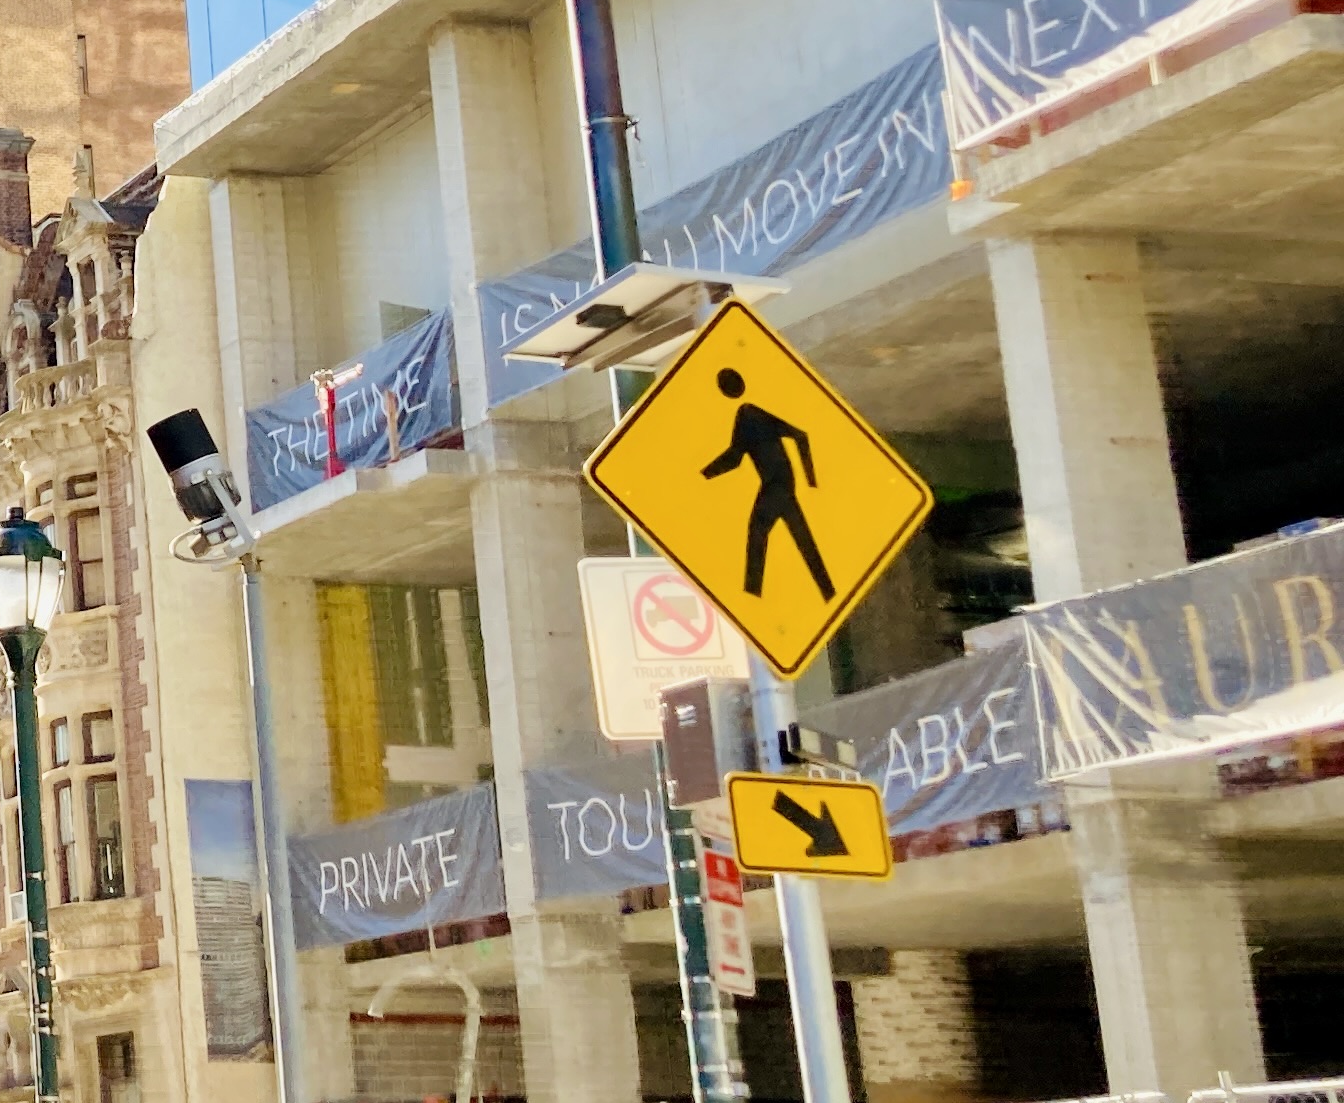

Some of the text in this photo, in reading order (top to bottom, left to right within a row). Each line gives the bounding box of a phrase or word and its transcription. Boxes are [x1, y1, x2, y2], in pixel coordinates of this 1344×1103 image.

[712, 133, 862, 273] MOVE
[878, 92, 935, 178] IN
[268, 355, 428, 476] THE TIME
[632, 664, 736, 679] TRUCK PARKING
[547, 788, 664, 860] TOU
[318, 827, 461, 915] PRIVATE
